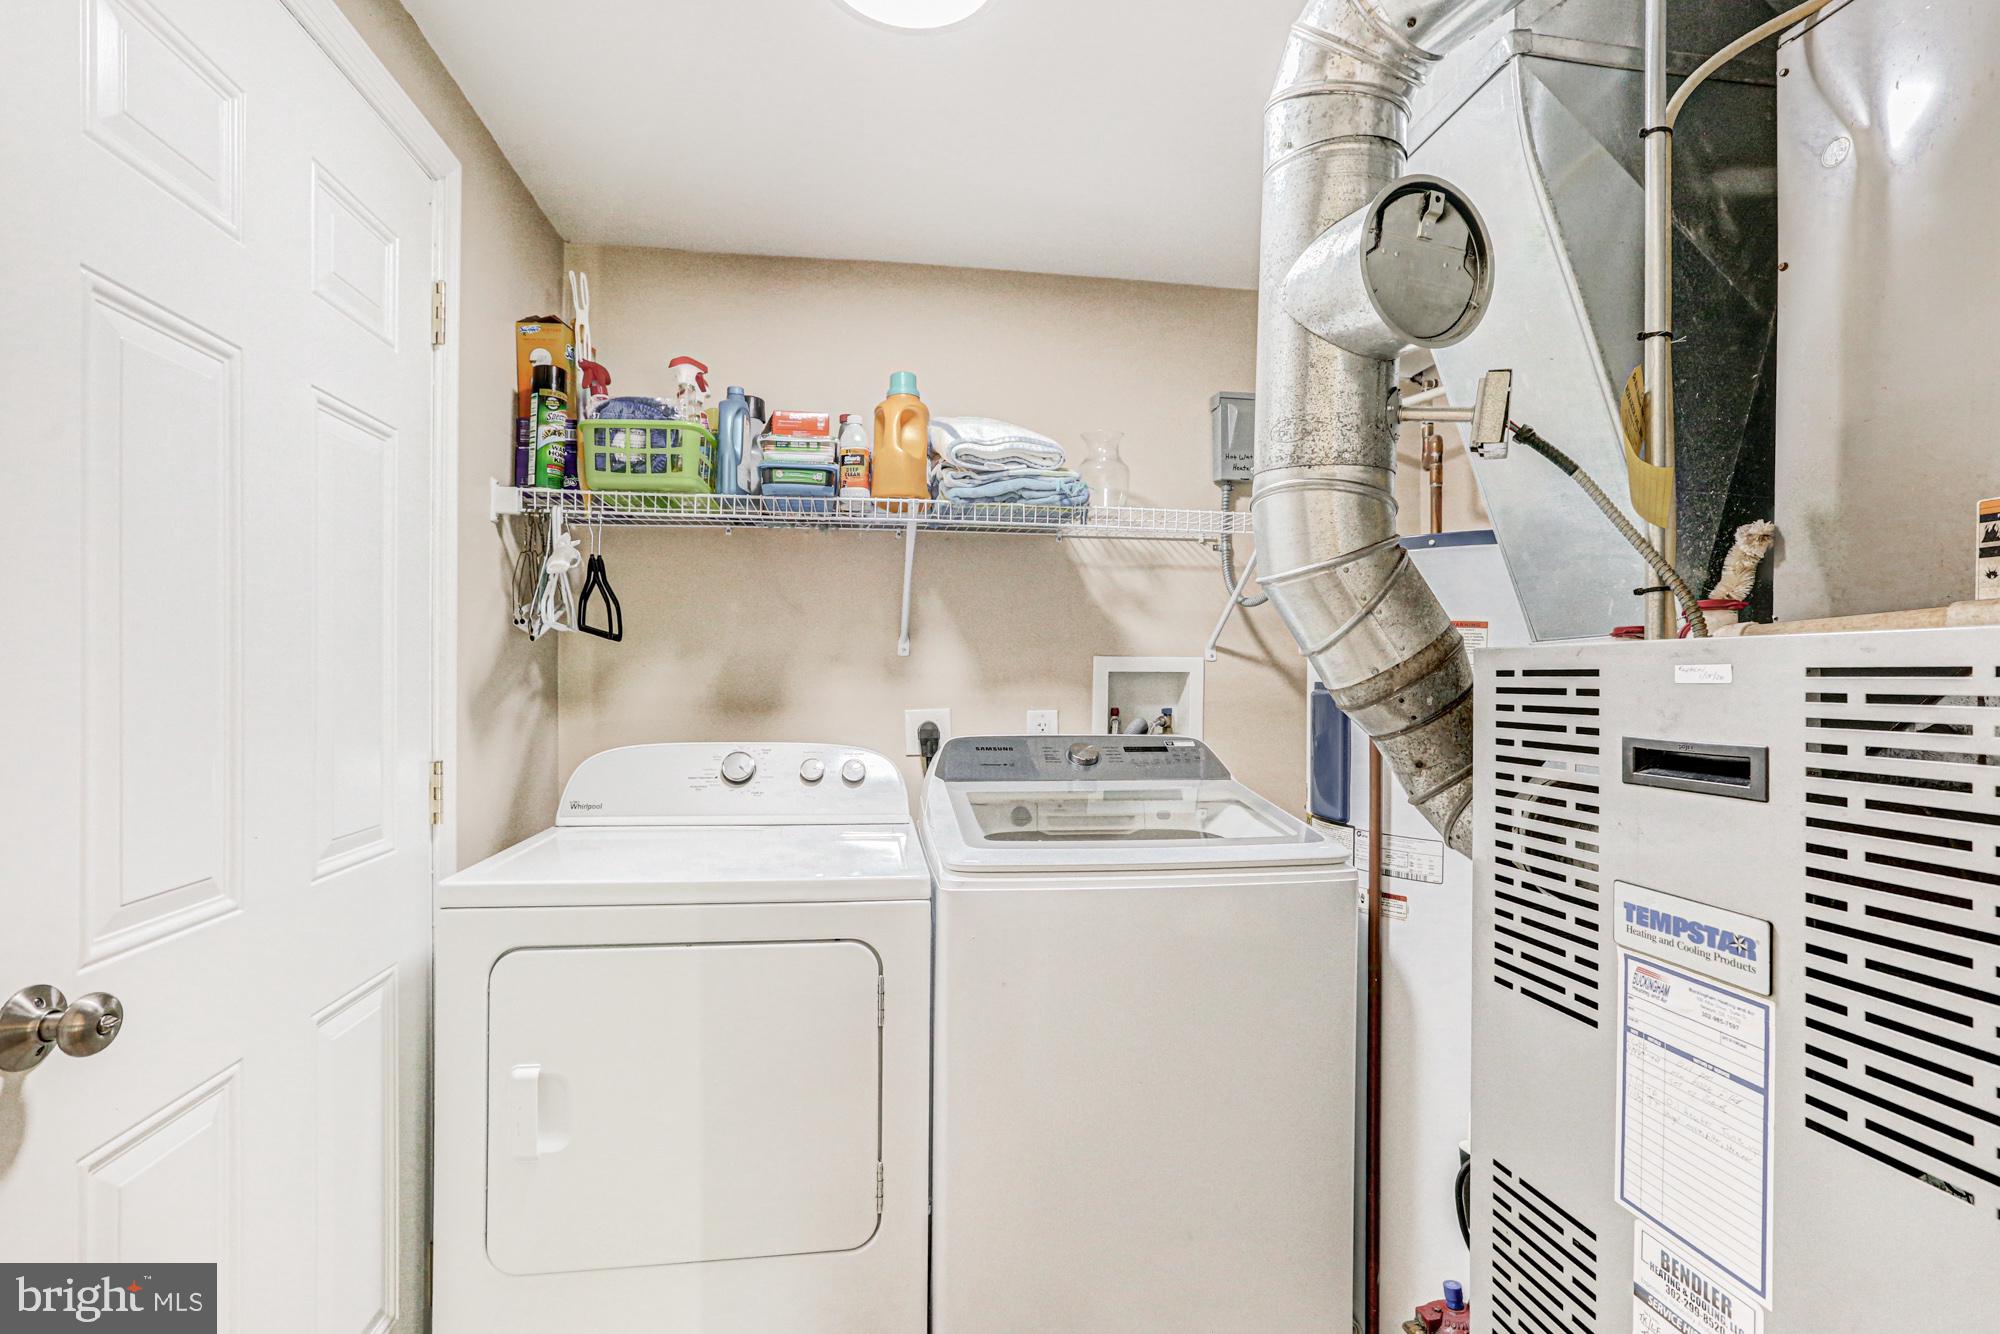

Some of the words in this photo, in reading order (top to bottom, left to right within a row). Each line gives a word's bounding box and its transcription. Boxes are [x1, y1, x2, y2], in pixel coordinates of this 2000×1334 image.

[570, 802, 603, 811] Whirlpool
[1624, 901, 1757, 962] TEMPSTAR
[1626, 924, 1657, 943] Heating
[1658, 935, 1674, 948] and
[1676, 941, 1711, 961] Cooling
[1713, 951, 1757, 974] Products
[1632, 972, 1671, 997] BUCKINGHAM
[1649, 1261, 1681, 1292] HEATING
[1682, 1287, 1689, 1298] &
[1660, 1249, 1733, 1319] BENDLER
[1647, 1295, 1685, 1332] SERVICE
[1665, 1284, 1726, 1334] 302-299-8520
